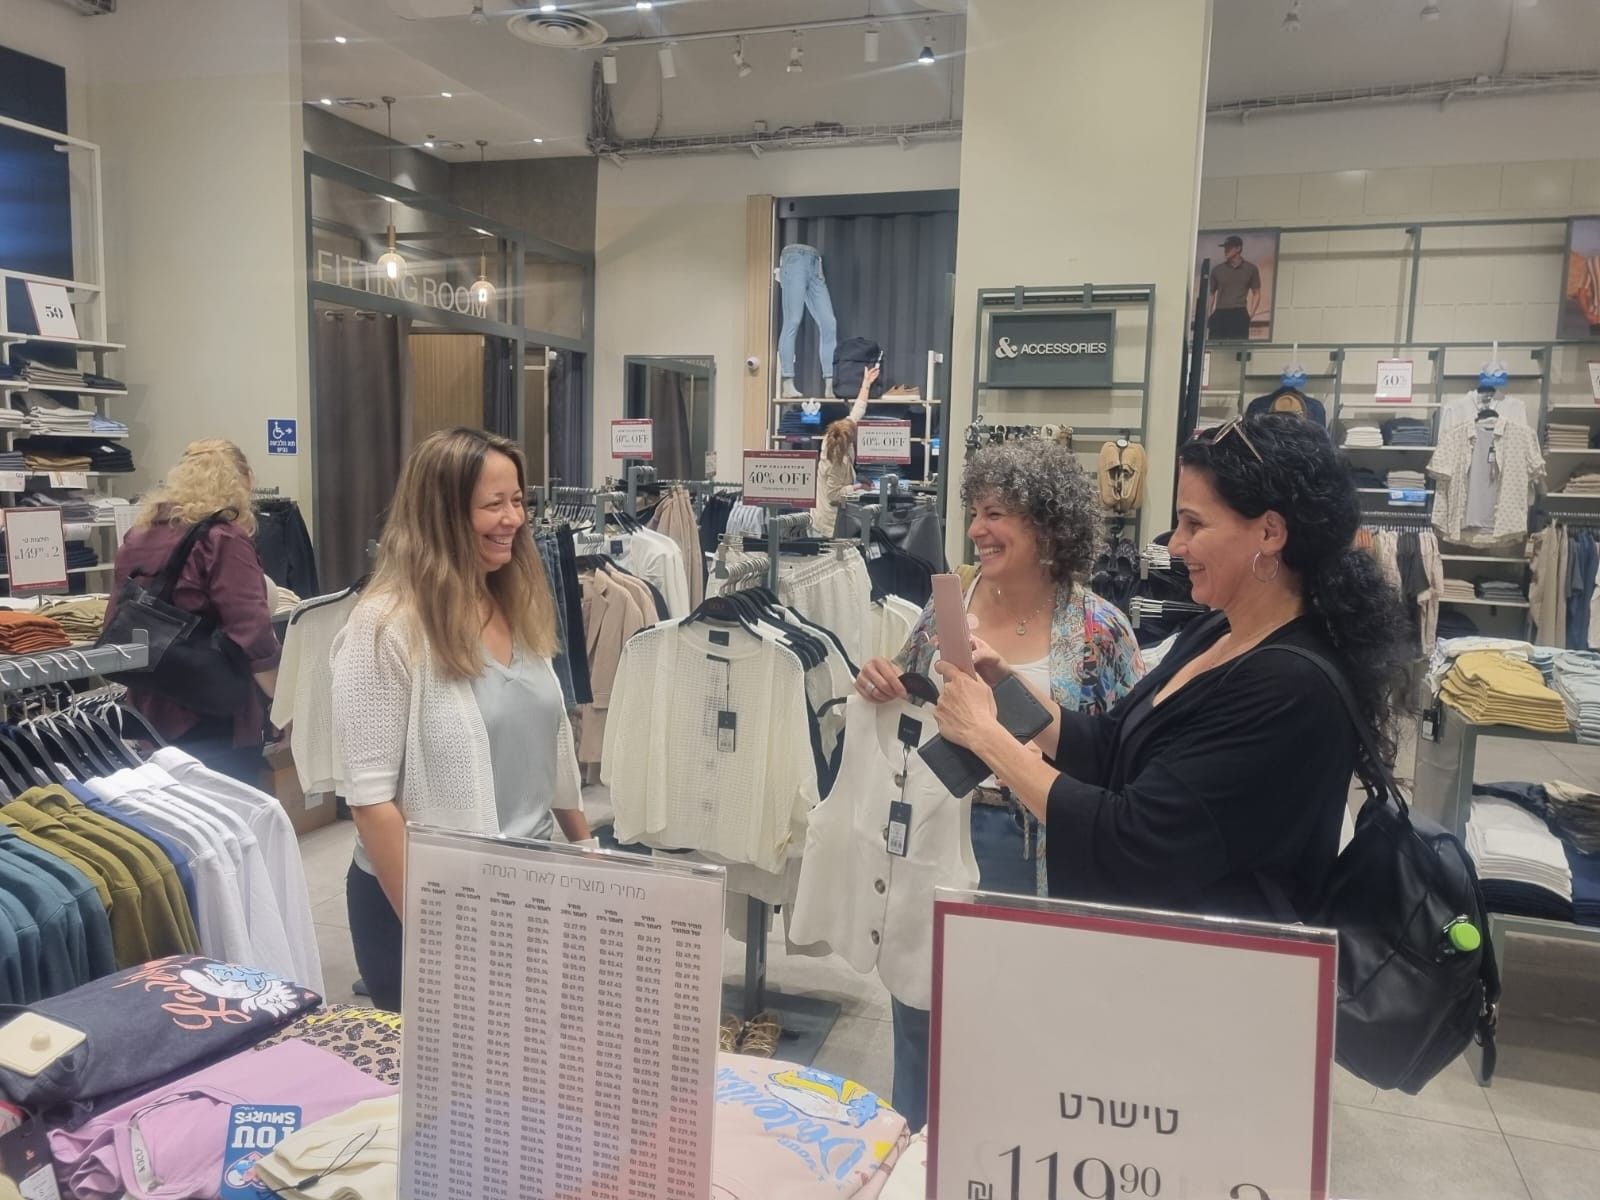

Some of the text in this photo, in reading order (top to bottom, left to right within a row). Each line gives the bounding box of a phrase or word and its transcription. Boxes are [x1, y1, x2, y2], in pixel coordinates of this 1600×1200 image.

[318, 250, 487, 318] FITTING ROOM
[1020, 343, 1107, 355] ACCESSORIES
[631, 434, 649, 443] OFF
[882, 437, 907, 447] OFF
[749, 471, 811, 485] 40% OFF
[481, 863, 646, 900] מחירי מוצרים לאחר הנחה
[234, 1111, 296, 1125] SMURFS
[1058, 1090, 1179, 1136] טישרט
